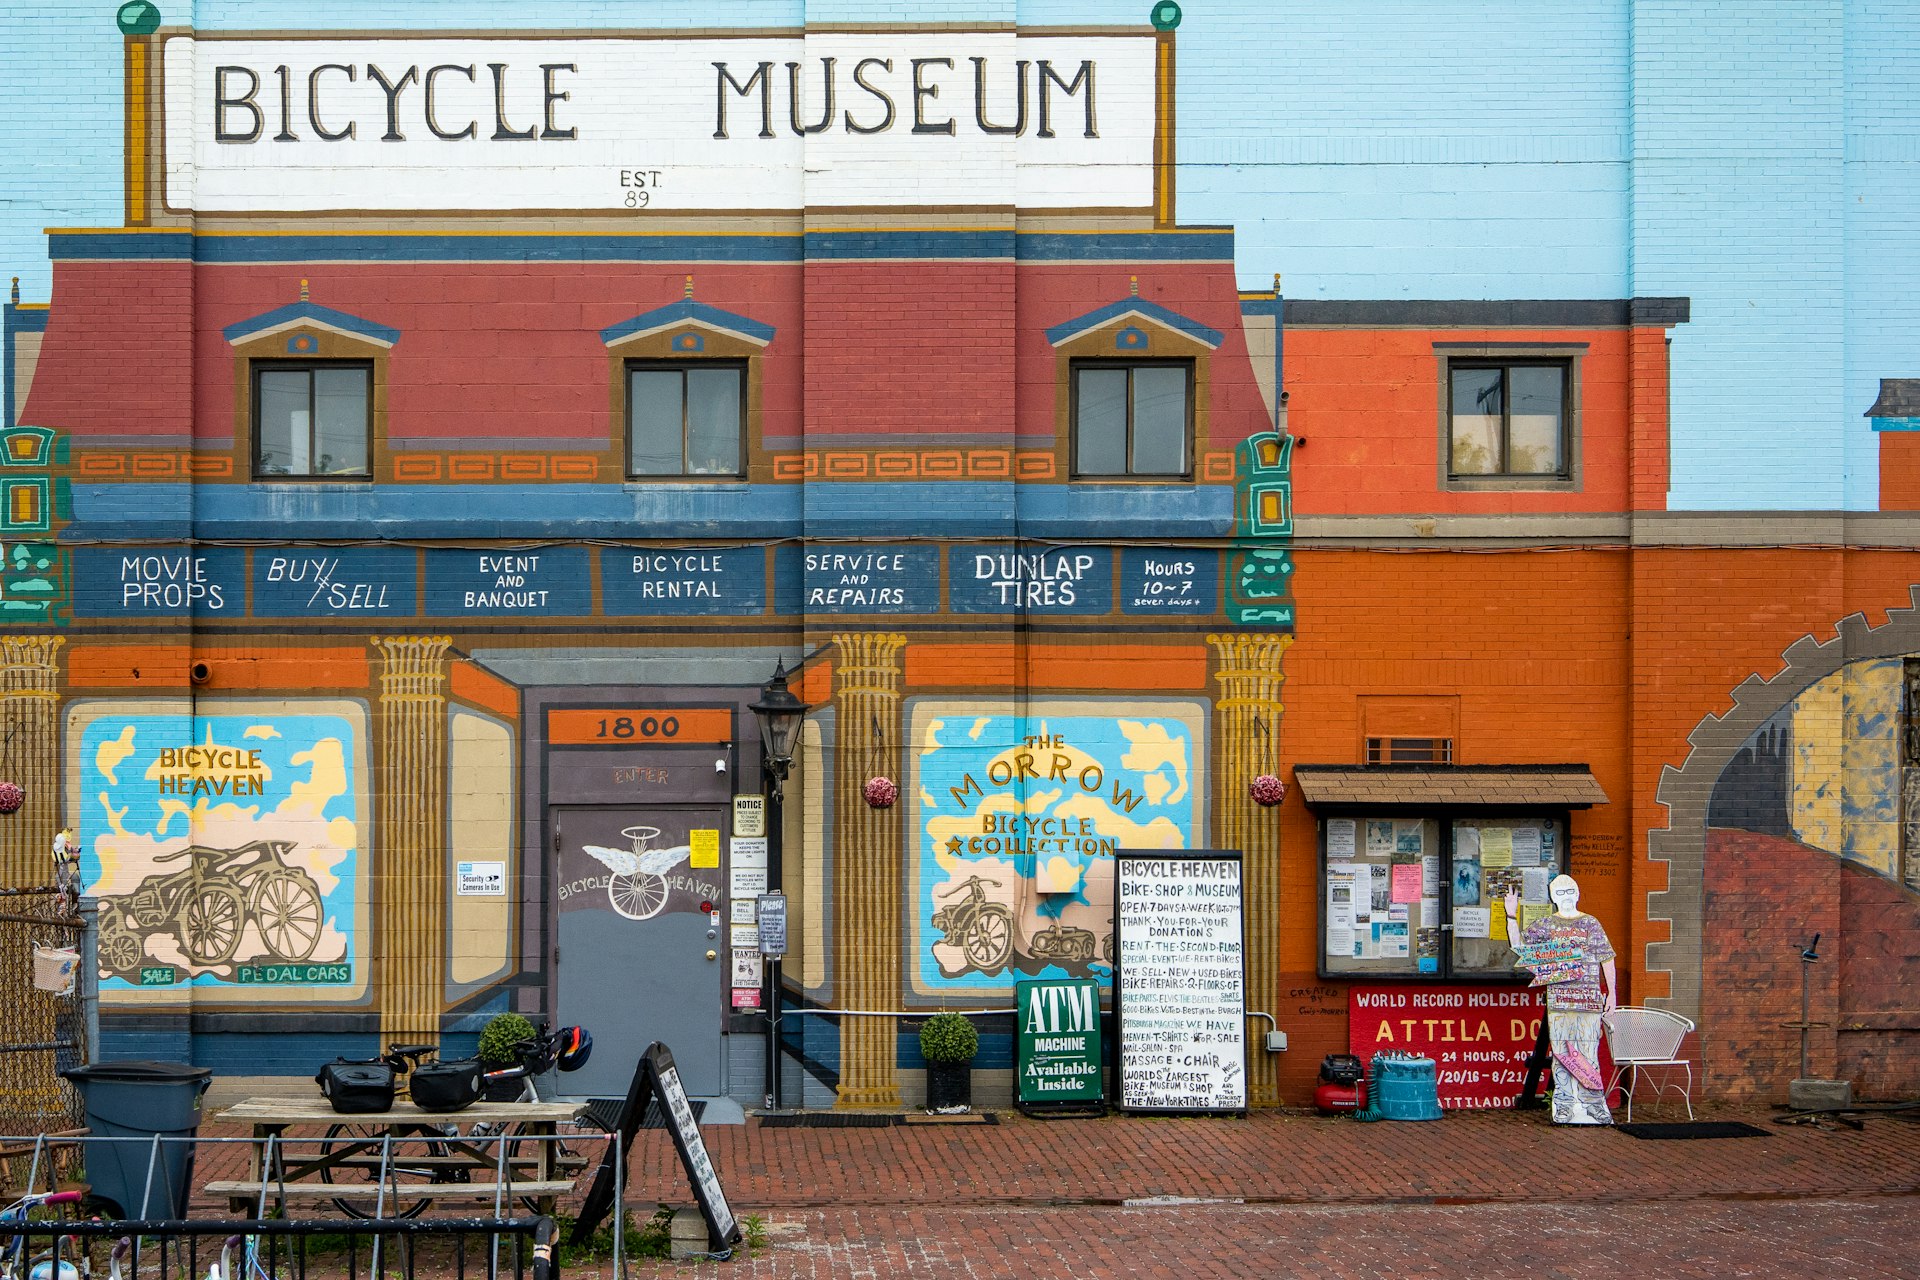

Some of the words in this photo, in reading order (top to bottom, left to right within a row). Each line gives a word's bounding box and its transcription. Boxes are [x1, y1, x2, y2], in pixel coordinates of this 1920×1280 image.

[215, 63, 578, 144] BICYCLE
[711, 56, 1100, 138] MUSEUM
[620, 170, 662, 188] EST.
[625, 191, 650, 207] 89
[121, 556, 207, 582] MOVIE
[478, 556, 540, 573] EVENT
[632, 555, 722, 573] BICYCLE
[806, 554, 904, 571] SERVICE
[975, 554, 1093, 580] DUNLAP
[495, 575, 525, 588] AND
[840, 574, 868, 585] AND
[123, 582, 224, 609] PROPS
[643, 580, 722, 599] RENTAL
[810, 588, 904, 606] REPAIRS
[991, 581, 1075, 608] TIRES
[464, 590, 549, 608] BANQUET
[1134, 598, 1164, 606] seven
[596, 716, 680, 738] 1800
[1023, 734, 1064, 750] THE
[159, 748, 262, 770] BICYCLE
[614, 767, 669, 785] ENTER
[949, 753, 1144, 813] MORROW
[159, 773, 264, 796] HEAVEN
[736, 800, 762, 809] NOTICE
[982, 814, 1092, 837] BICYCLE
[968, 836, 1115, 857] COLLECTION
[1181, 861, 1238, 879] HEAVEN
[462, 874, 484, 883] Security
[462, 883, 484, 891] Cameras
[491, 883, 500, 891] Use
[558, 875, 610, 900] BICYCLE
[667, 875, 721, 901] HEAVEN
[1155, 884, 1184, 897] SHOP
[1195, 884, 1240, 898] MUSEUM
[760, 899, 783, 912] Please
[1120, 902, 1148, 913] OPEN
[1121, 917, 1151, 927] THANK
[1122, 940, 1151, 951] RENT
[1155, 941, 1176, 952] THE
[1180, 941, 1217, 952] SECOND
[142, 969, 171, 983] SALE
[241, 968, 301, 983] PEDAL
[306, 966, 347, 981] CARS
[1122, 967, 1137, 976] WE
[1141, 967, 1162, 977] SELL
[1168, 967, 1189, 977] NEW
[1290, 986, 1338, 997] CREATED
[1356, 993, 1406, 1008] WORLD
[1413, 993, 1463, 1007] RECORD
[1468, 992, 1530, 1007] HOLDER
[1024, 985, 1095, 1034] ATM
[1217, 1033, 1240, 1043] SALE
[1375, 1018, 1493, 1043] ATTILA
[1034, 1037, 1086, 1052] MACHINE
[1123, 1055, 1173, 1067] MASSAGE
[1442, 1051, 1457, 1062] 24
[1024, 1061, 1097, 1076] Available
[1037, 1076, 1085, 1091] Inside
[1165, 1072, 1210, 1083] LARGEST
